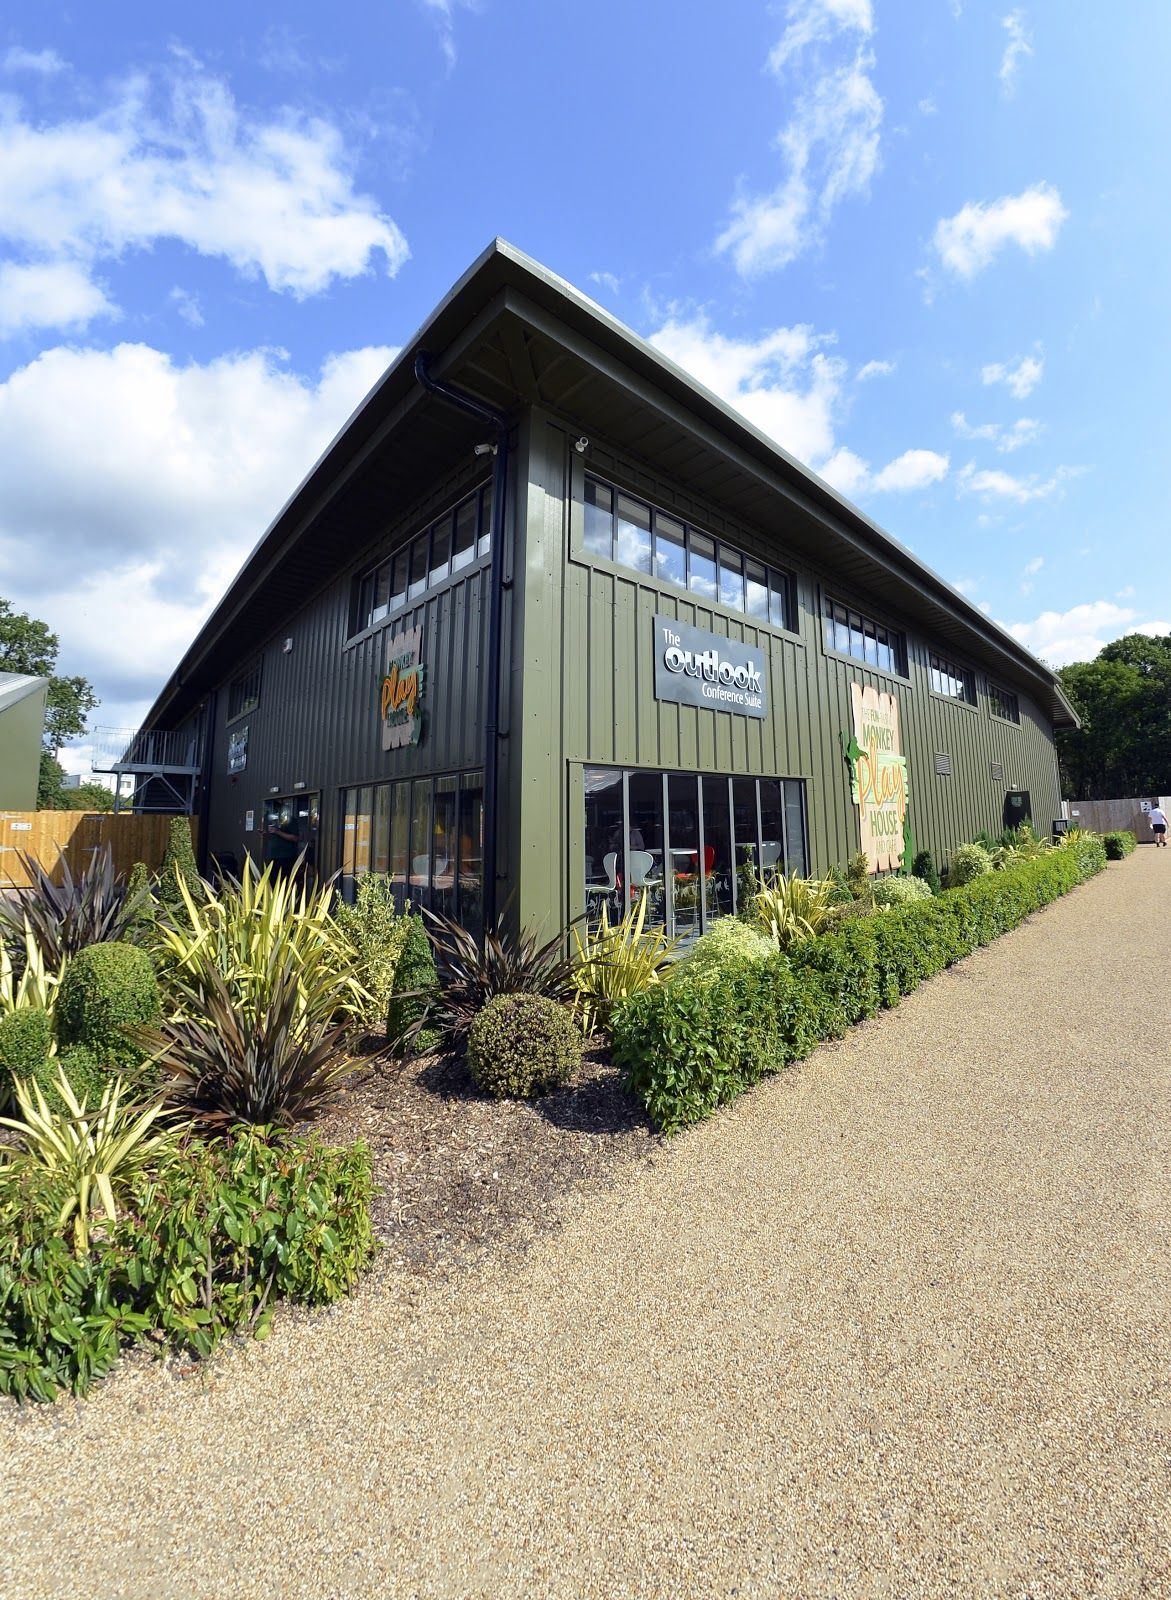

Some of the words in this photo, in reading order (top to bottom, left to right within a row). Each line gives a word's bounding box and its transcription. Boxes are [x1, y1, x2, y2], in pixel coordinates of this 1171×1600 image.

[663, 628, 681, 647] The
[664, 646, 762, 693] outlook
[702, 682, 744, 705] Conference
[744, 692, 762, 708] Suite
[870, 810, 898, 837] HOUSE
